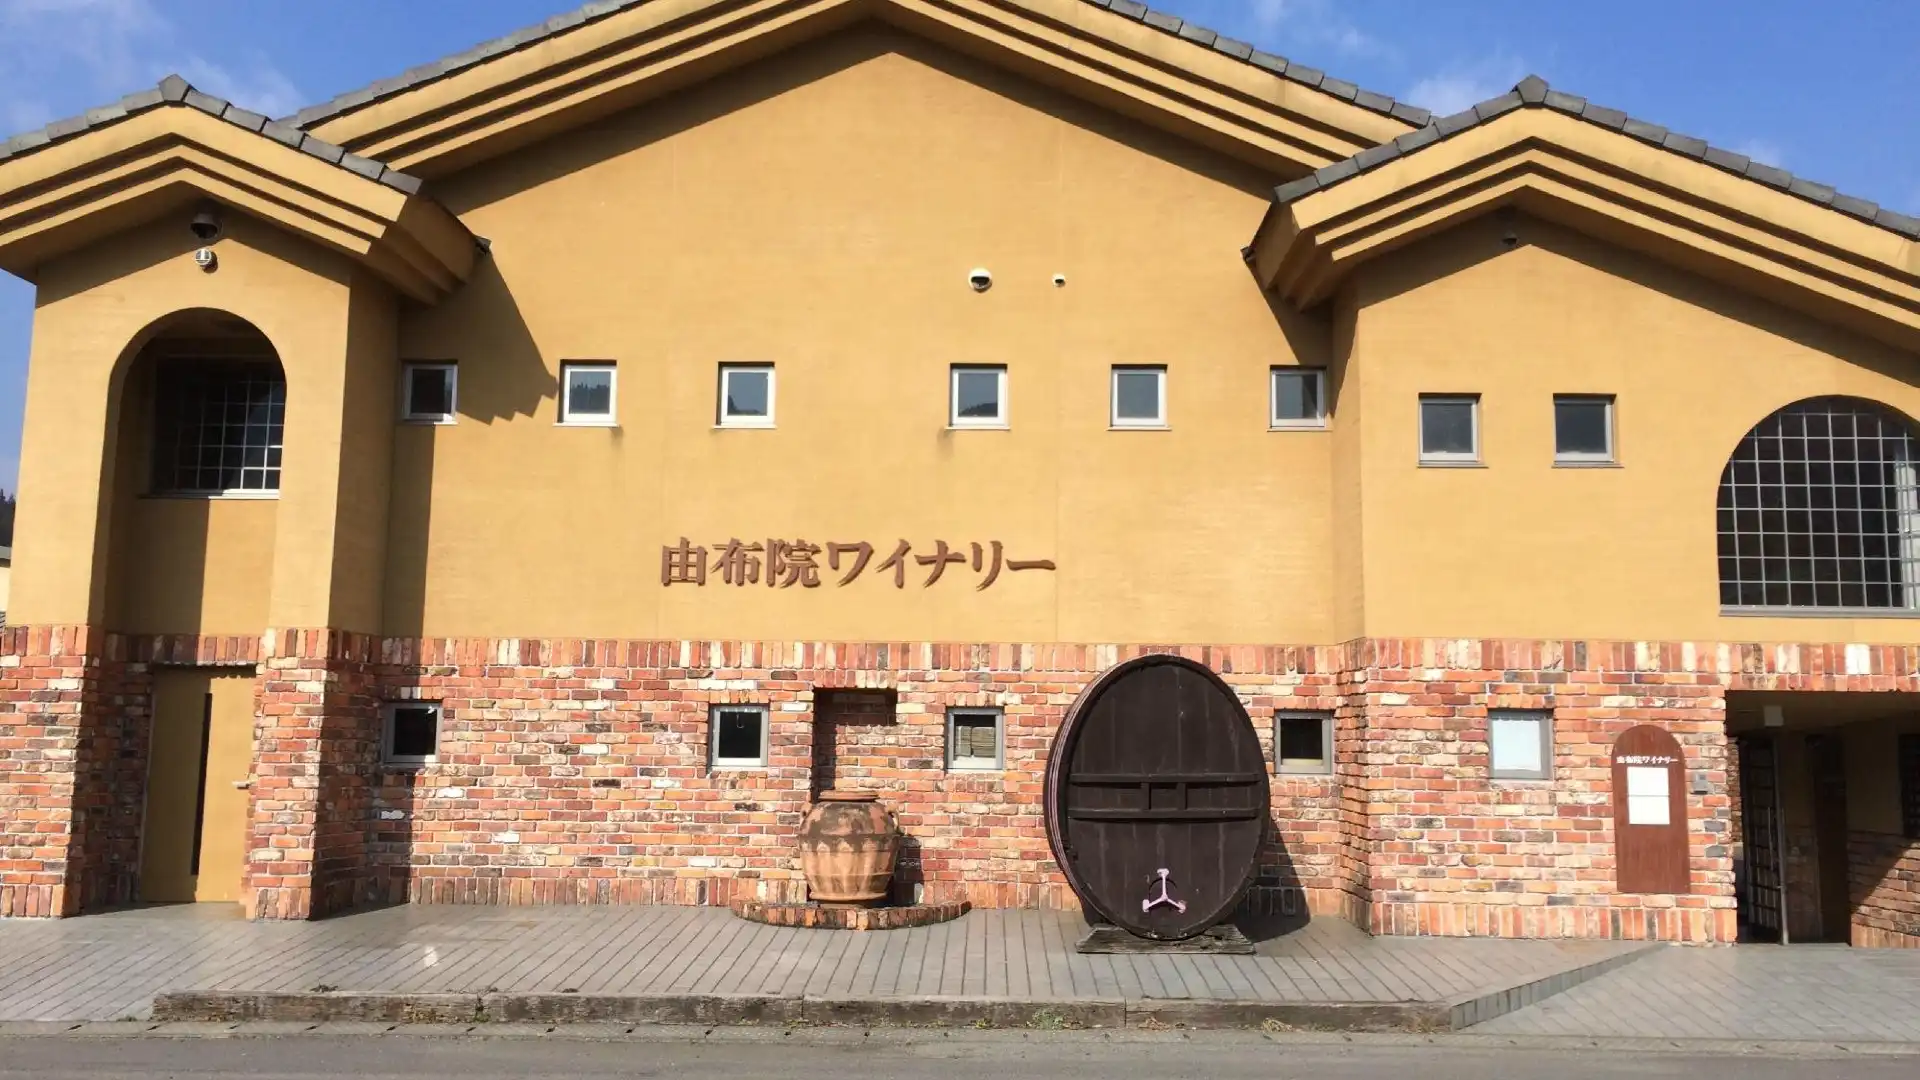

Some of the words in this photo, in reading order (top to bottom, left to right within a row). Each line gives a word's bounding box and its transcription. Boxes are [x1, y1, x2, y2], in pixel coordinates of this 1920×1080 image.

[661, 537, 1056, 591] 由布院ワイナリー
